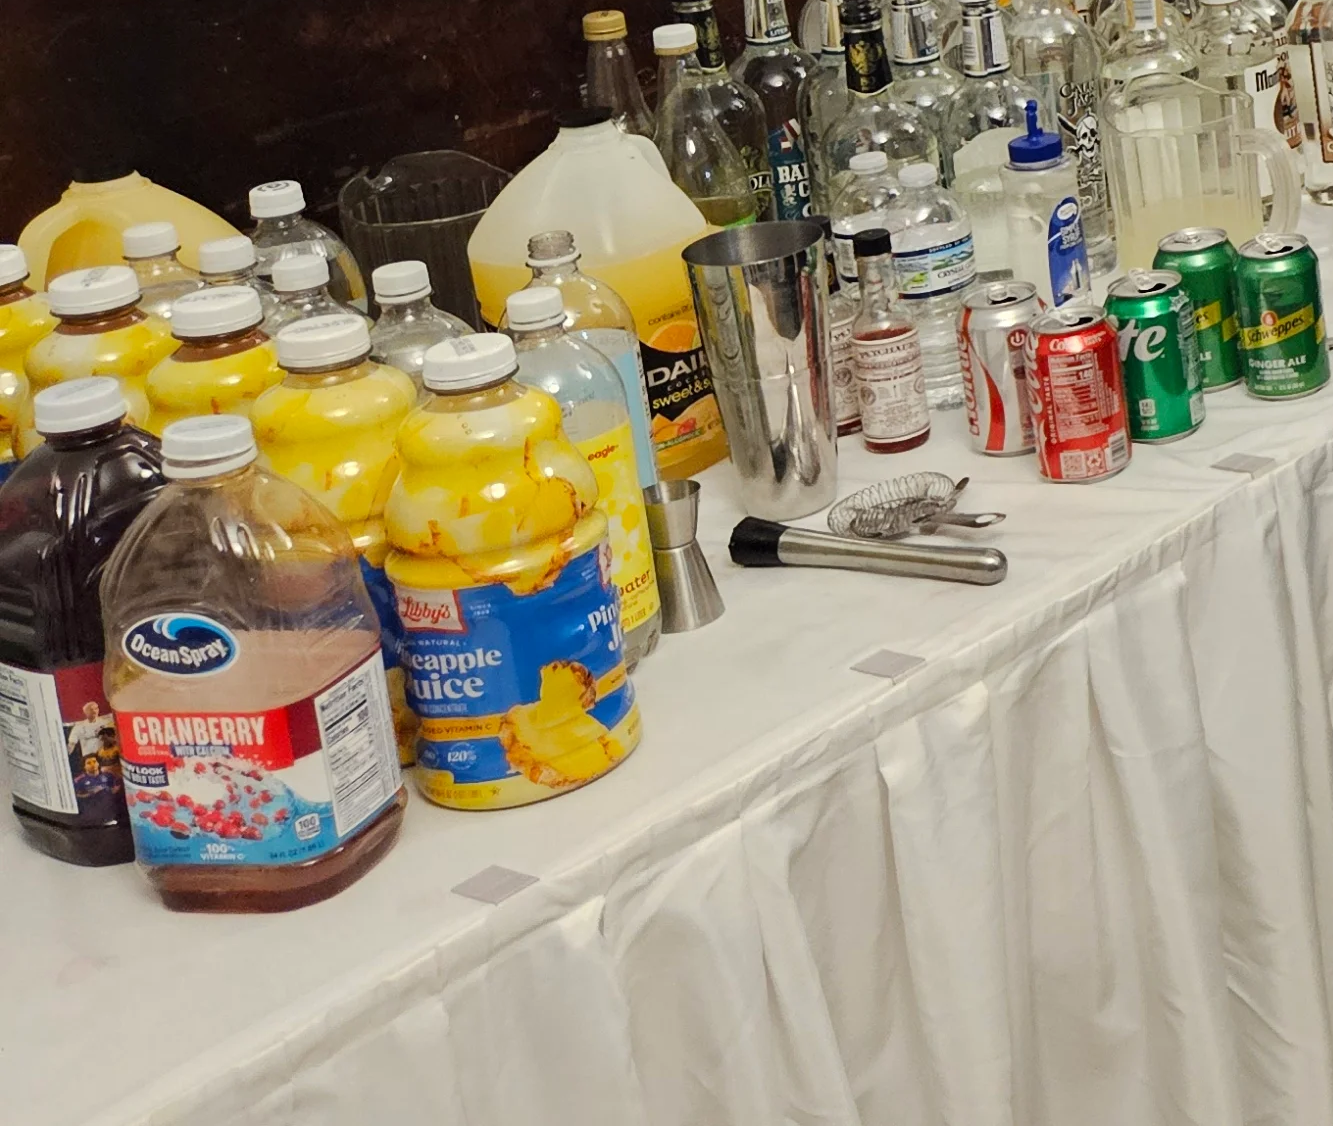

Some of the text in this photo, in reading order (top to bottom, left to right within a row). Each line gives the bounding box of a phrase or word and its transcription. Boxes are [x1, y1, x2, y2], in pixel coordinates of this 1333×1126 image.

[1247, 314, 1305, 343] Schweppes
[1249, 355, 1307, 369] GINGER ALE
[1043, 376, 1058, 445] ORIGINAL TASTE
[587, 444, 616, 461] eagle
[401, 596, 451, 623] Libby's
[413, 672, 485, 700] uice
[133, 716, 266, 746] CRANBERRY
[444, 724, 483, 735] VITAMIN
[485, 723, 493, 731] C
[138, 766, 164, 775] LOOK
[200, 853, 236, 861] VITAMIN
